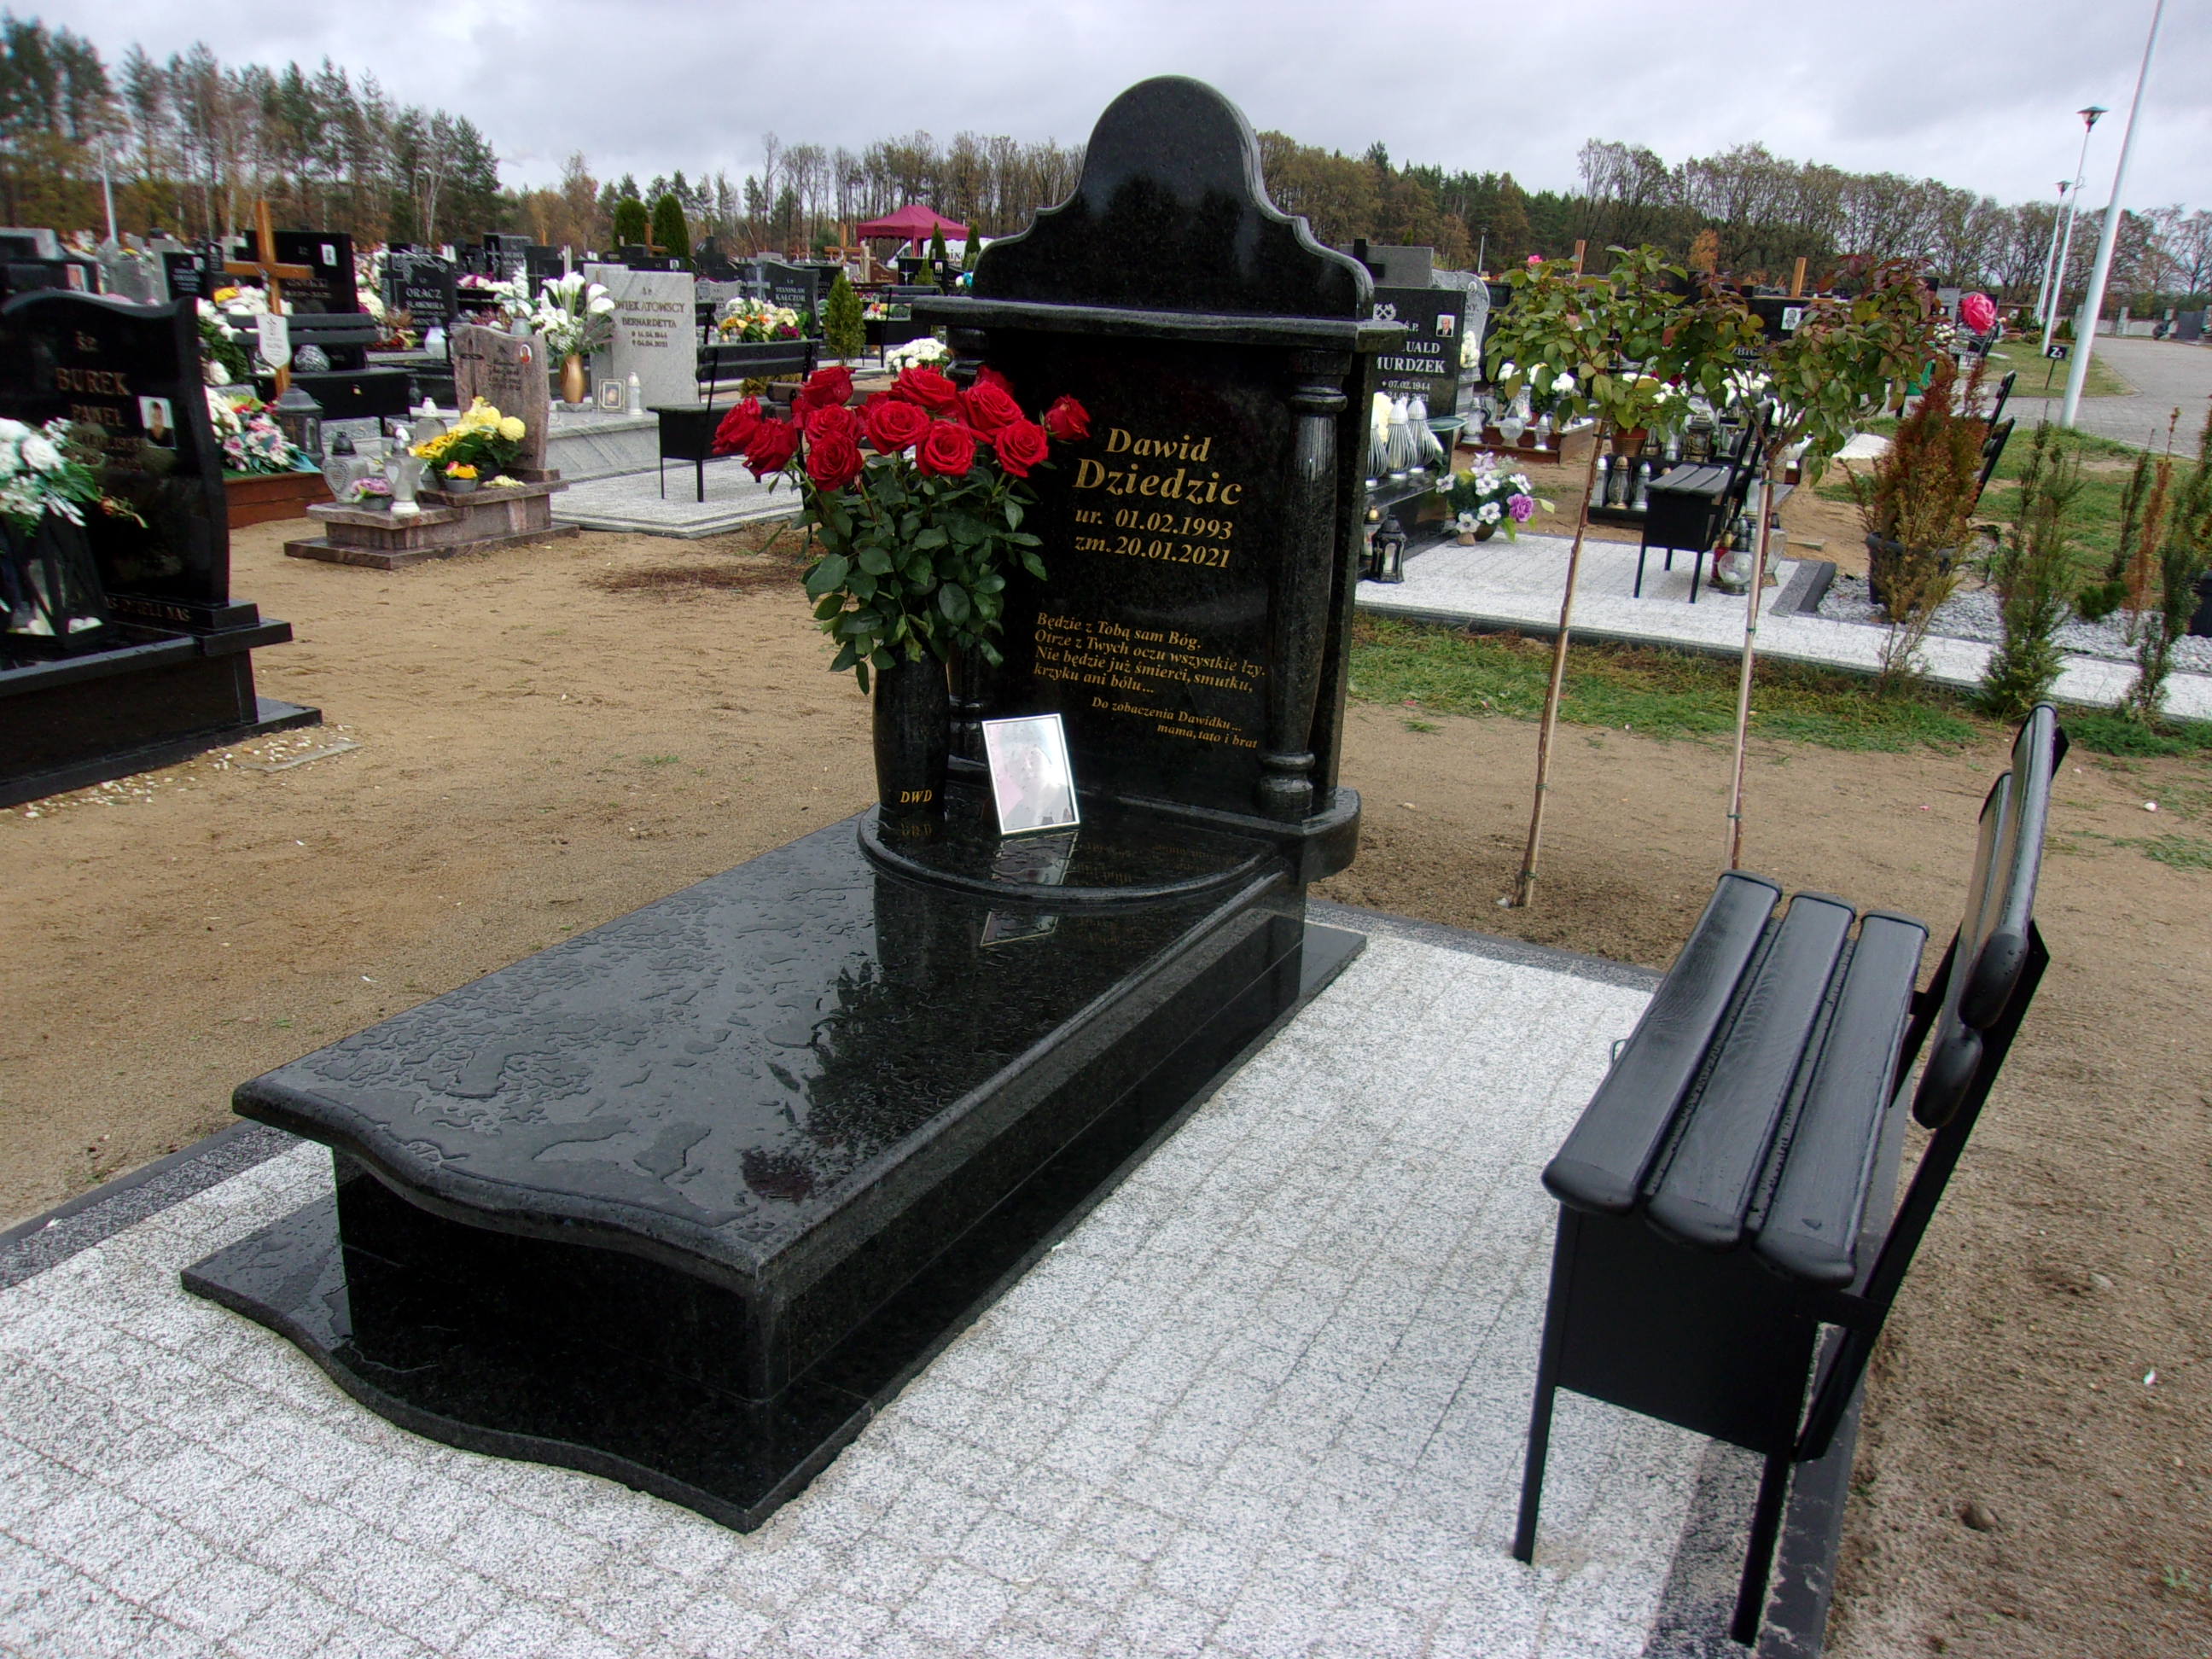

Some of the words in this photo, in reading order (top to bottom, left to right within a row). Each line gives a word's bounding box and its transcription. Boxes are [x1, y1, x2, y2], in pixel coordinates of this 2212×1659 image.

[1404, 341, 1441, 353] UALD
[55, 367, 131, 396] BUREK
[1106, 428, 1211, 462] Dawid
[1072, 457, 1242, 505] Dziedzic
[1075, 509, 1103, 525] ur.
[1115, 509, 1233, 539] 01.02.1993
[1074, 536, 1111, 553] zm.
[1115, 536, 1231, 568] 20.01.2021
[1037, 612, 1082, 630] Będzie
[1086, 623, 1092, 633] z
[1097, 620, 1132, 641] Tobą
[1133, 630, 1164, 643] sam
[1168, 631, 1202, 651] Bóg.
[1034, 629, 1072, 646] Otrze
[1075, 638, 1082, 649] z
[1086, 636, 1128, 655] Twych
[1132, 647, 1166, 661] oczu
[1170, 652, 1237, 672] wszystkie
[1033, 662, 1080, 681] krzyku
[1083, 672, 1107, 685] ani
[1035, 645, 1060, 661] Nie
[1063, 650, 1106, 668] będzie
[1107, 657, 1131, 673] już
[1134, 661, 1190, 684] śmierci,
[1193, 673, 1253, 694] smutku,
[1091, 696, 1109, 709] Do
[1112, 702, 1174, 720] zobaczenia
[1224, 733, 1229, 744] i
[1231, 734, 1258, 749] brat
[900, 789, 932, 803] DWD
